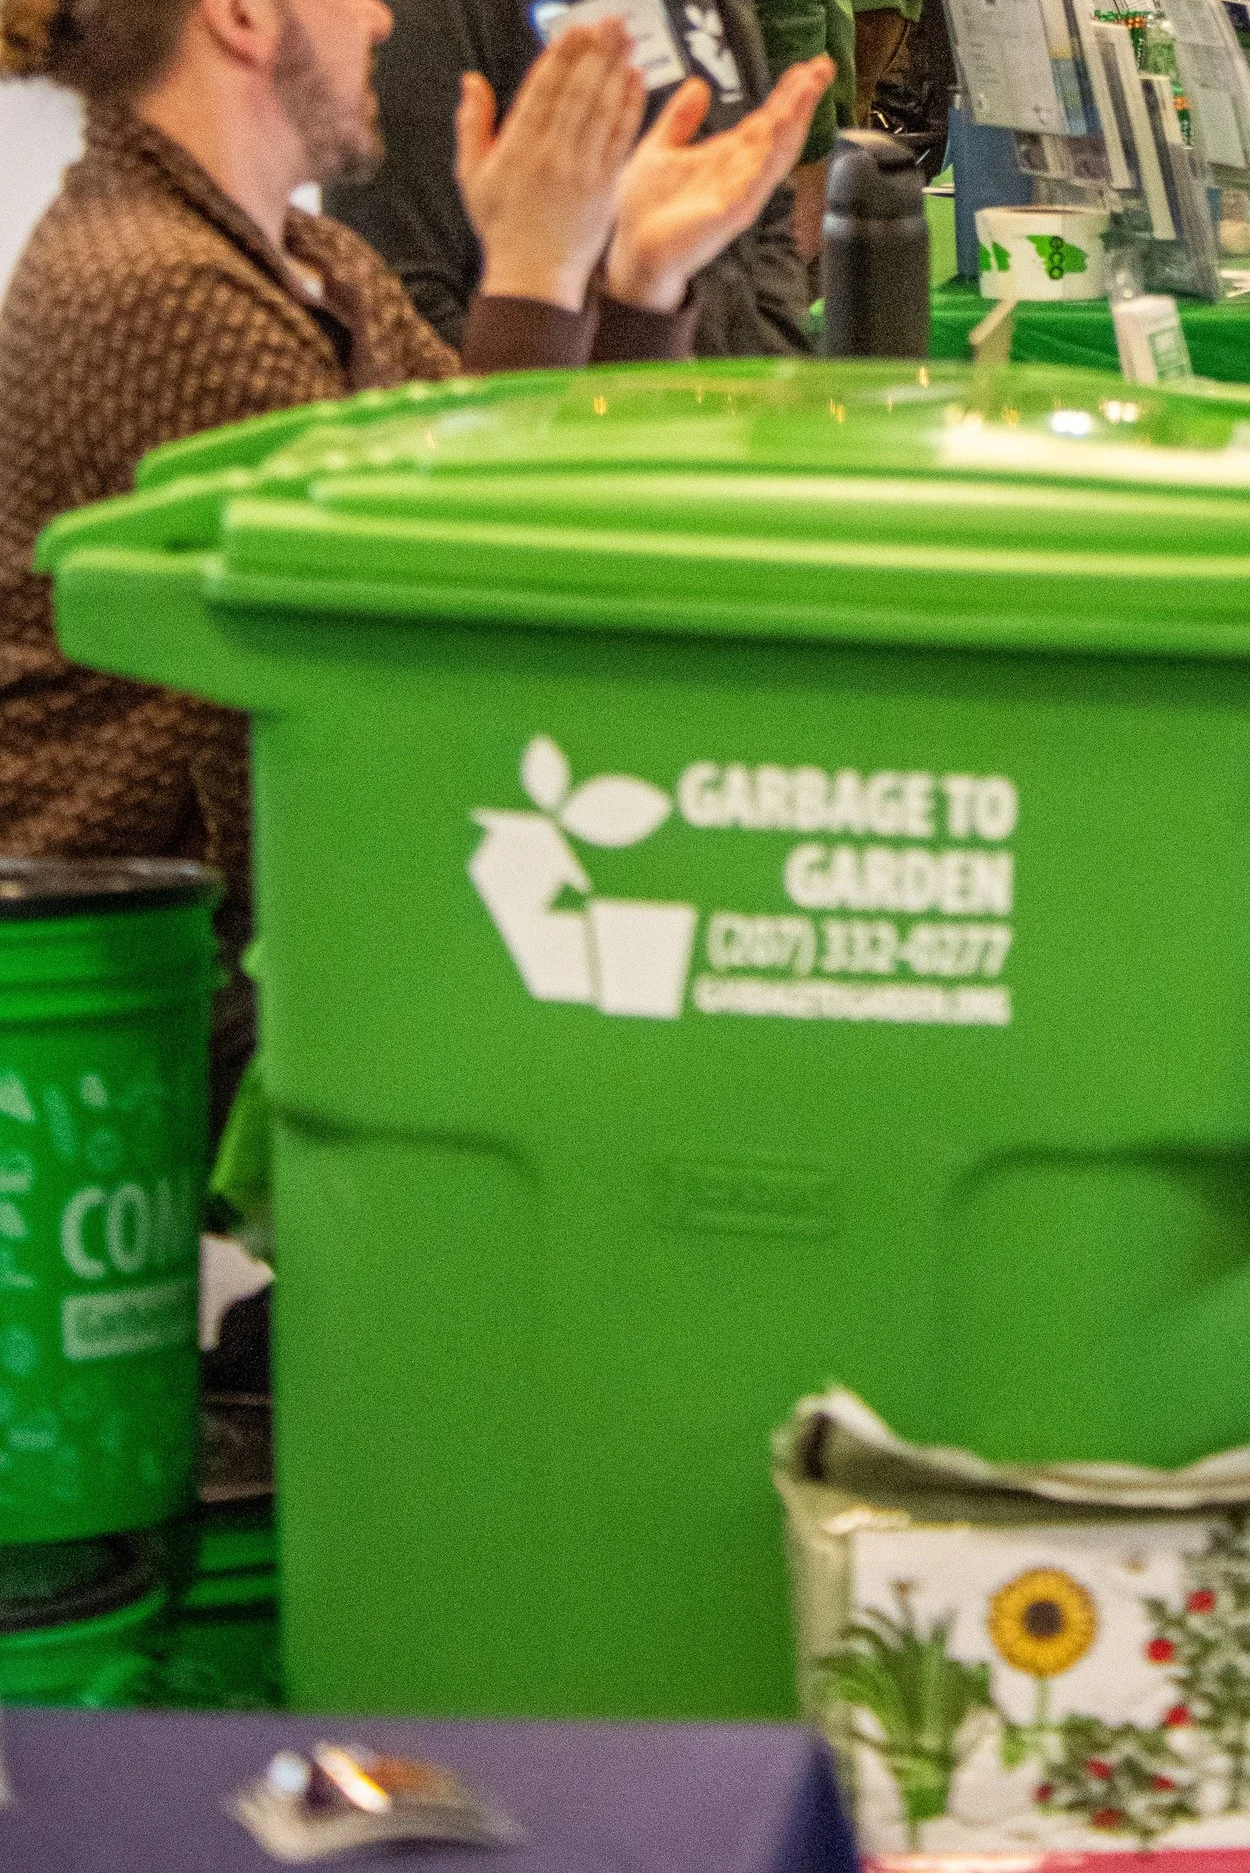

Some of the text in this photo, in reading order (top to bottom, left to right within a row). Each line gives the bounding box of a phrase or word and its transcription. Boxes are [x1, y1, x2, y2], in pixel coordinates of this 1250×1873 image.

[677, 761, 1018, 840] GARBAGE TO
[784, 844, 1015, 915] GARDEN
